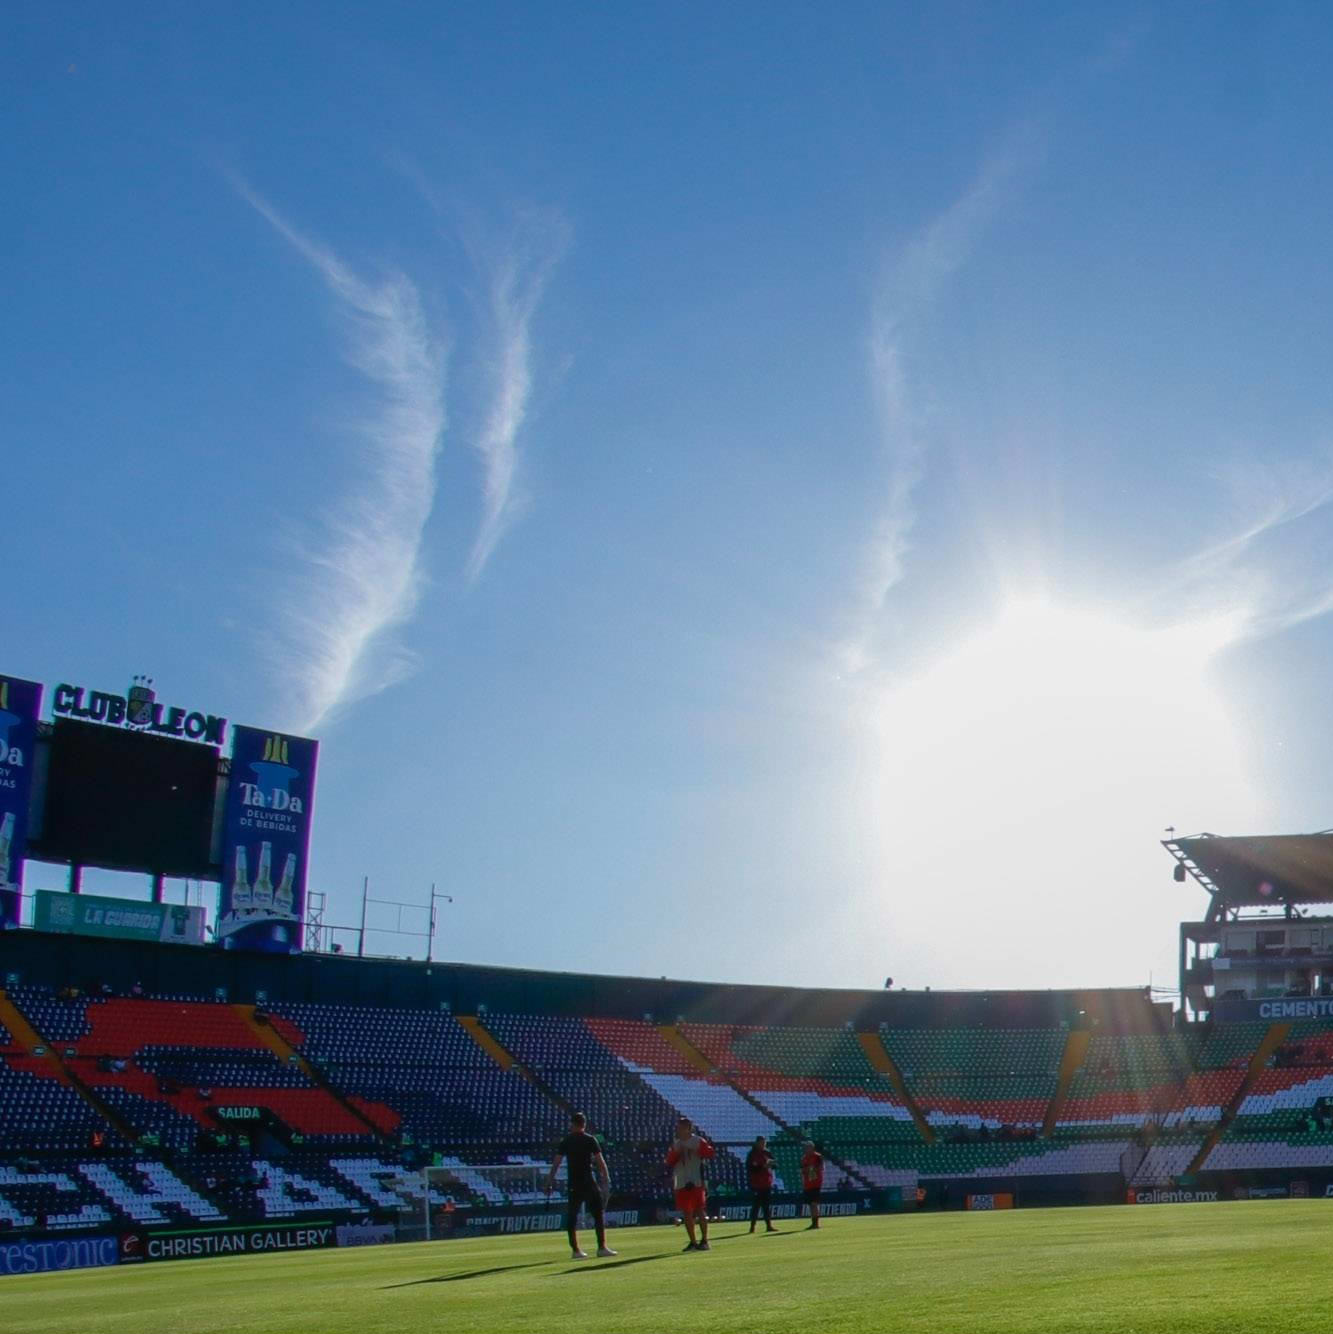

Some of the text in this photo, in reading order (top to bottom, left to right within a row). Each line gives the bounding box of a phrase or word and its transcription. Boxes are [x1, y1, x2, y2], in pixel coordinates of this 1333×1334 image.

[54, 684, 227, 745] CLUB LEON
[247, 809, 292, 823] DELIVERY
[240, 817, 297, 832] DE BEBIDAS
[218, 1107, 260, 1119] SALIDA
[1136, 1187, 1217, 1204] caliente.mx
[148, 1236, 246, 1258] CHRISTIAN
[251, 1230, 328, 1251] GALLERY
